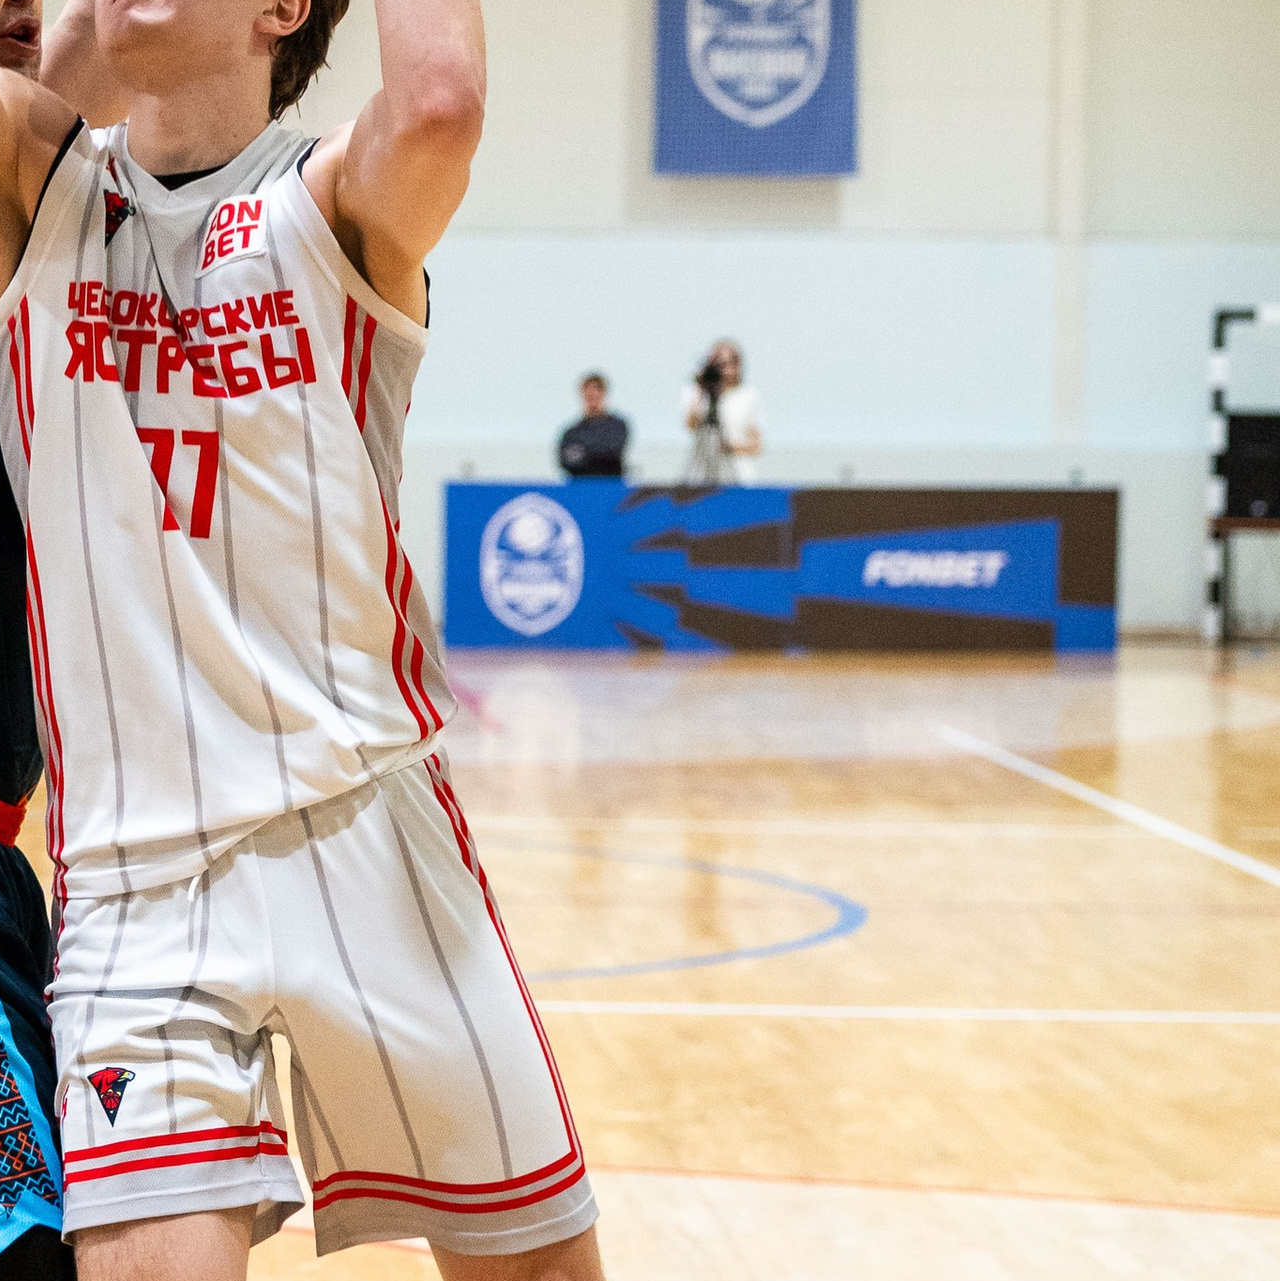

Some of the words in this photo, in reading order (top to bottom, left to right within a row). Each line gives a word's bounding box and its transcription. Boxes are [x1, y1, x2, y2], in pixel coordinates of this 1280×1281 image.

[201, 224, 259, 270] BET
[205, 200, 263, 245] FON
[64, 321, 317, 398] ЯСТРЕБЫ
[135, 427, 219, 539] 77
